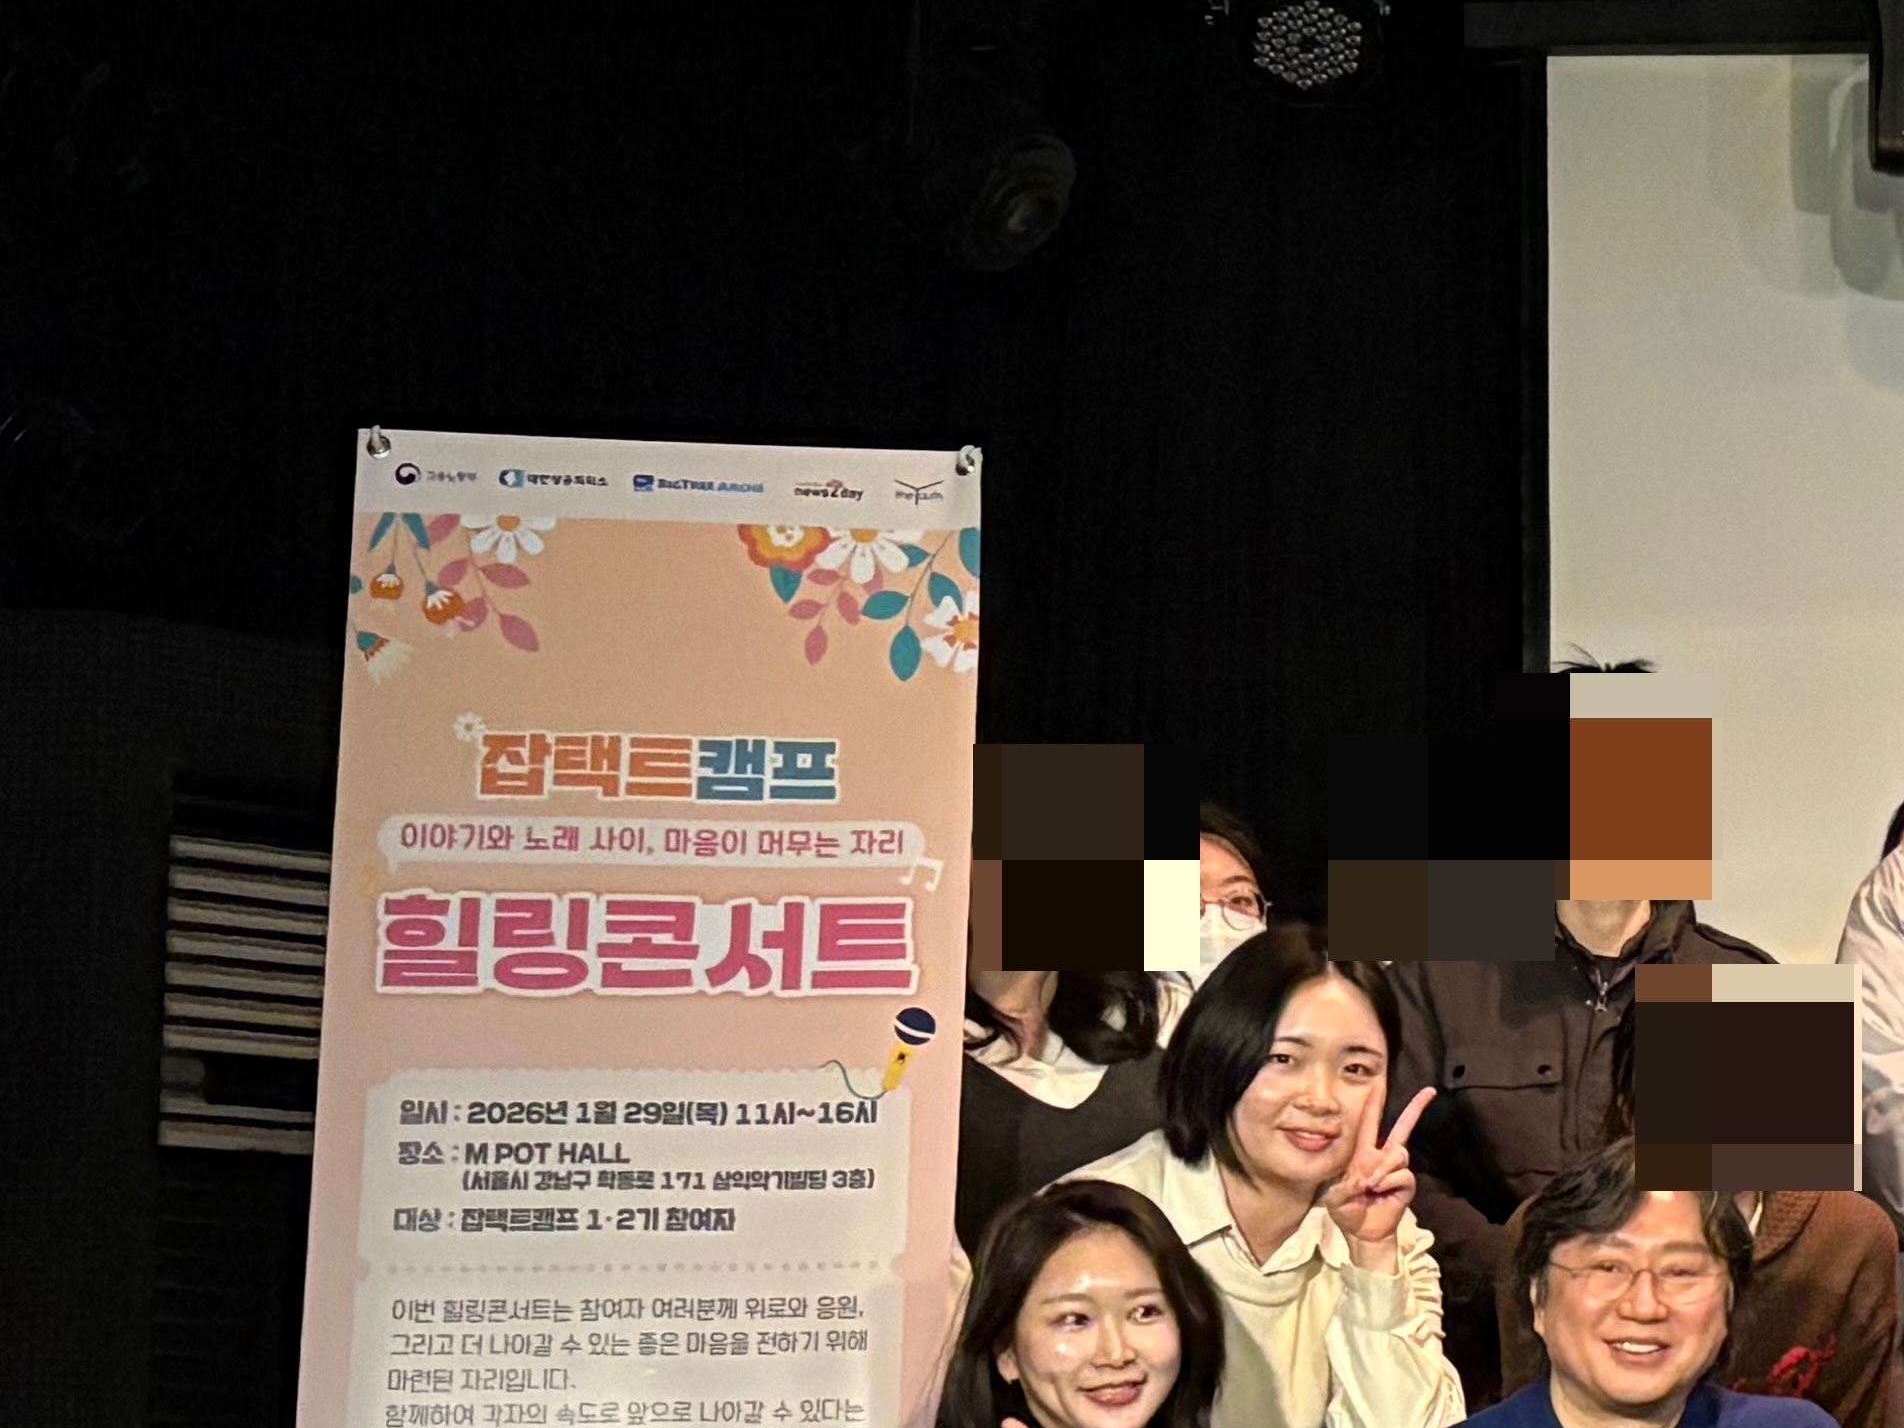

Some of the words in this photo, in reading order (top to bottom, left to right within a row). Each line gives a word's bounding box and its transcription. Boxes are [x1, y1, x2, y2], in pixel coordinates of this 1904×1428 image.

[477, 731, 839, 803] 잡택트캠프
[400, 821, 514, 852] 이야기와
[523, 824, 580, 853] 노래
[589, 826, 655, 856] 사이,
[664, 828, 748, 859] 마음이
[758, 829, 841, 859] 머무는
[850, 828, 905, 857] 자리
[380, 892, 914, 991] 힐링콘서트
[399, 1100, 449, 1125] 일시
[467, 1100, 569, 1125] 2026년
[576, 1100, 618, 1125] 1월
[623, 1100, 729, 1126] 29일(목)
[735, 1099, 879, 1126] 11시~16시
[398, 1140, 446, 1165] 장소
[464, 1142, 489, 1164] M
[494, 1142, 552, 1164] POT
[558, 1142, 631, 1164] HALL
[462, 1169, 529, 1191] (서울시
[534, 1169, 592, 1191] 강남구
[660, 1171, 707, 1190] 171
[712, 1168, 828, 1191] 삼익악기빌딩
[831, 1167, 876, 1191] 3층)
[393, 1207, 442, 1232] 대상
[460, 1207, 580, 1233] 잡택트캠프
[664, 1206, 737, 1232] 참여자
[391, 1299, 436, 1323] 이번
[442, 1299, 574, 1323] 힐링콘서트는
[579, 1297, 645, 1322] 참여자
[652, 1297, 738, 1321] 여러분께
[745, 1297, 808, 1319] 위로와
[816, 1295, 865, 1320] 응원,
[389, 1333, 455, 1356] 그리고
[461, 1333, 483, 1356] 더
[489, 1333, 554, 1358] 나아갈
[560, 1333, 583, 1355] 수
[588, 1332, 630, 1356] 있는
[638, 1331, 680, 1356] 좋은
[686, 1331, 749, 1356] 마음을
[756, 1330, 819, 1356] 전하기
[825, 1329, 868, 1352] 위해
[387, 1368, 454, 1393] 마련된
[460, 1367, 577, 1393] 자리입니다.
[385, 1403, 476, 1428] 함께하여
[482, 1403, 547, 1428] 각자의
[556, 1401, 621, 1426] 속도로
[626, 1400, 693, 1426] 앞으로
[699, 1399, 765, 1425] 나아갈
[771, 1399, 794, 1422] 수
[800, 1398, 866, 1423] 있다는
